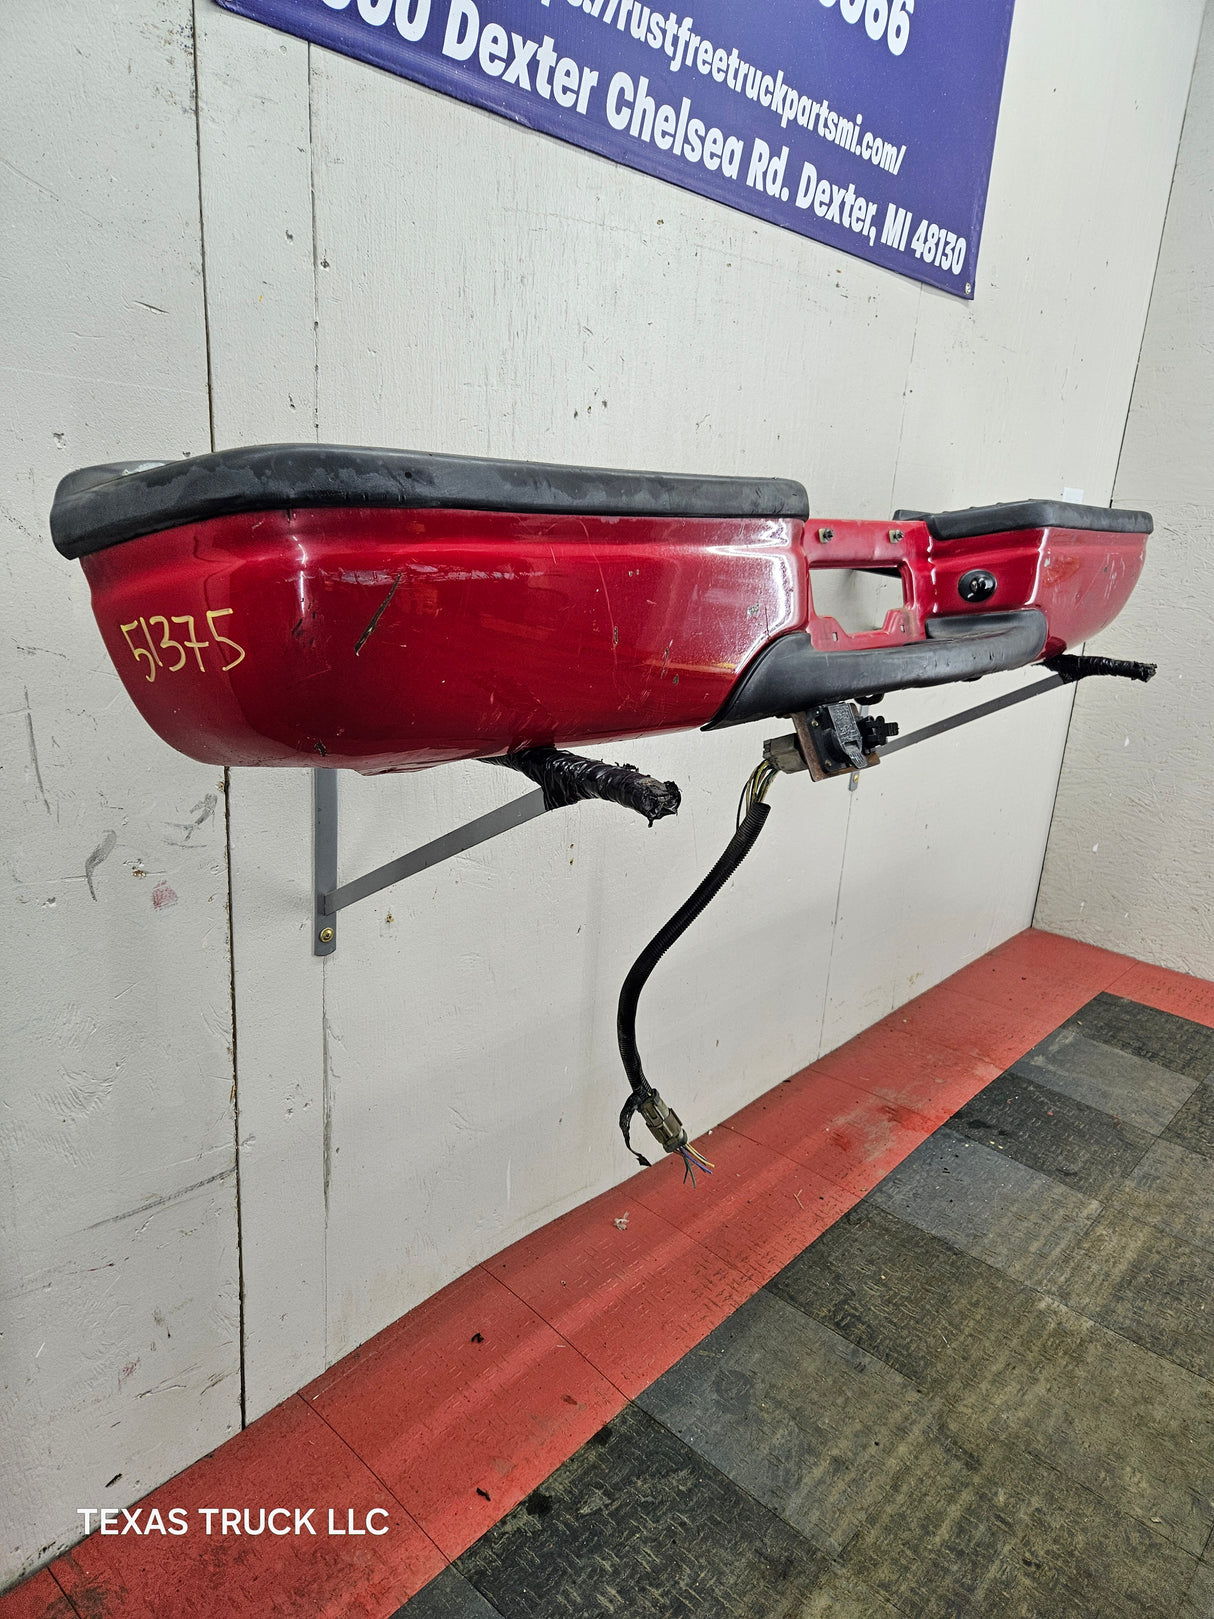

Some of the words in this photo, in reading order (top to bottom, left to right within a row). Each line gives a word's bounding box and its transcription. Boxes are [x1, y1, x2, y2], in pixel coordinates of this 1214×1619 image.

[442, 0, 598, 115] Dexter
[606, 71, 744, 180] Chelsea
[746, 138, 790, 202] Rd.
[796, 161, 877, 247] Dexter,
[881, 203, 912, 251] MI
[911, 219, 967, 275] 48130
[120, 608, 245, 682] 51375
